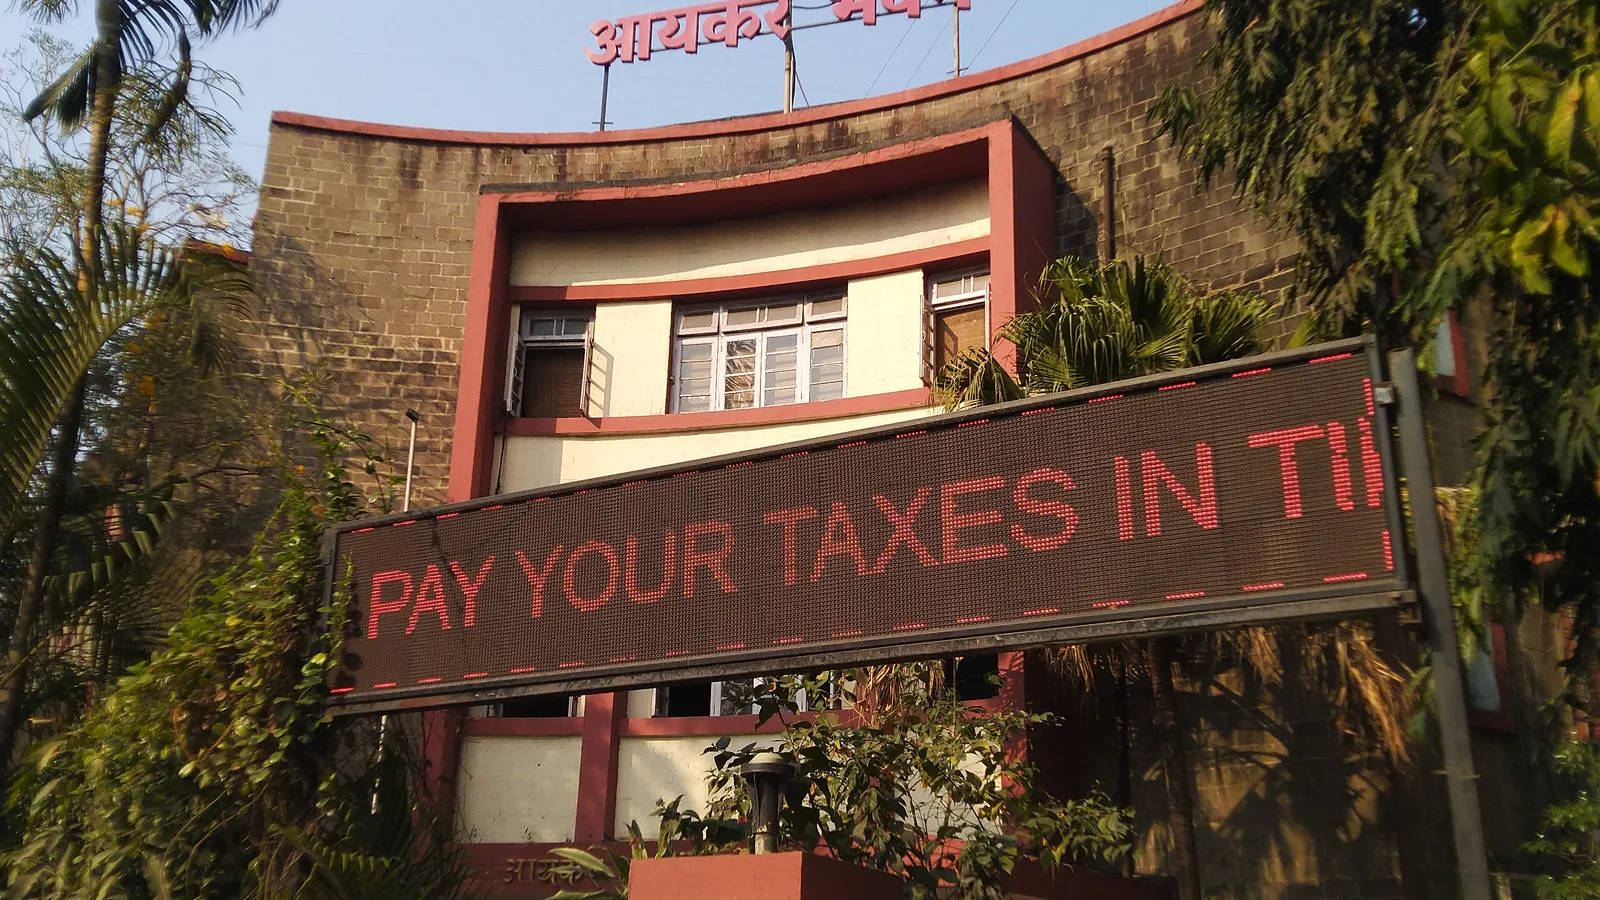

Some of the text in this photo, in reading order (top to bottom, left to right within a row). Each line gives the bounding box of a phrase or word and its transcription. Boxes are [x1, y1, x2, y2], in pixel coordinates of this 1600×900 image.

[367, 555, 496, 640] PAY
[514, 520, 739, 619] YOUR
[763, 466, 1080, 586] TAXES
[1113, 442, 1218, 540] IN
